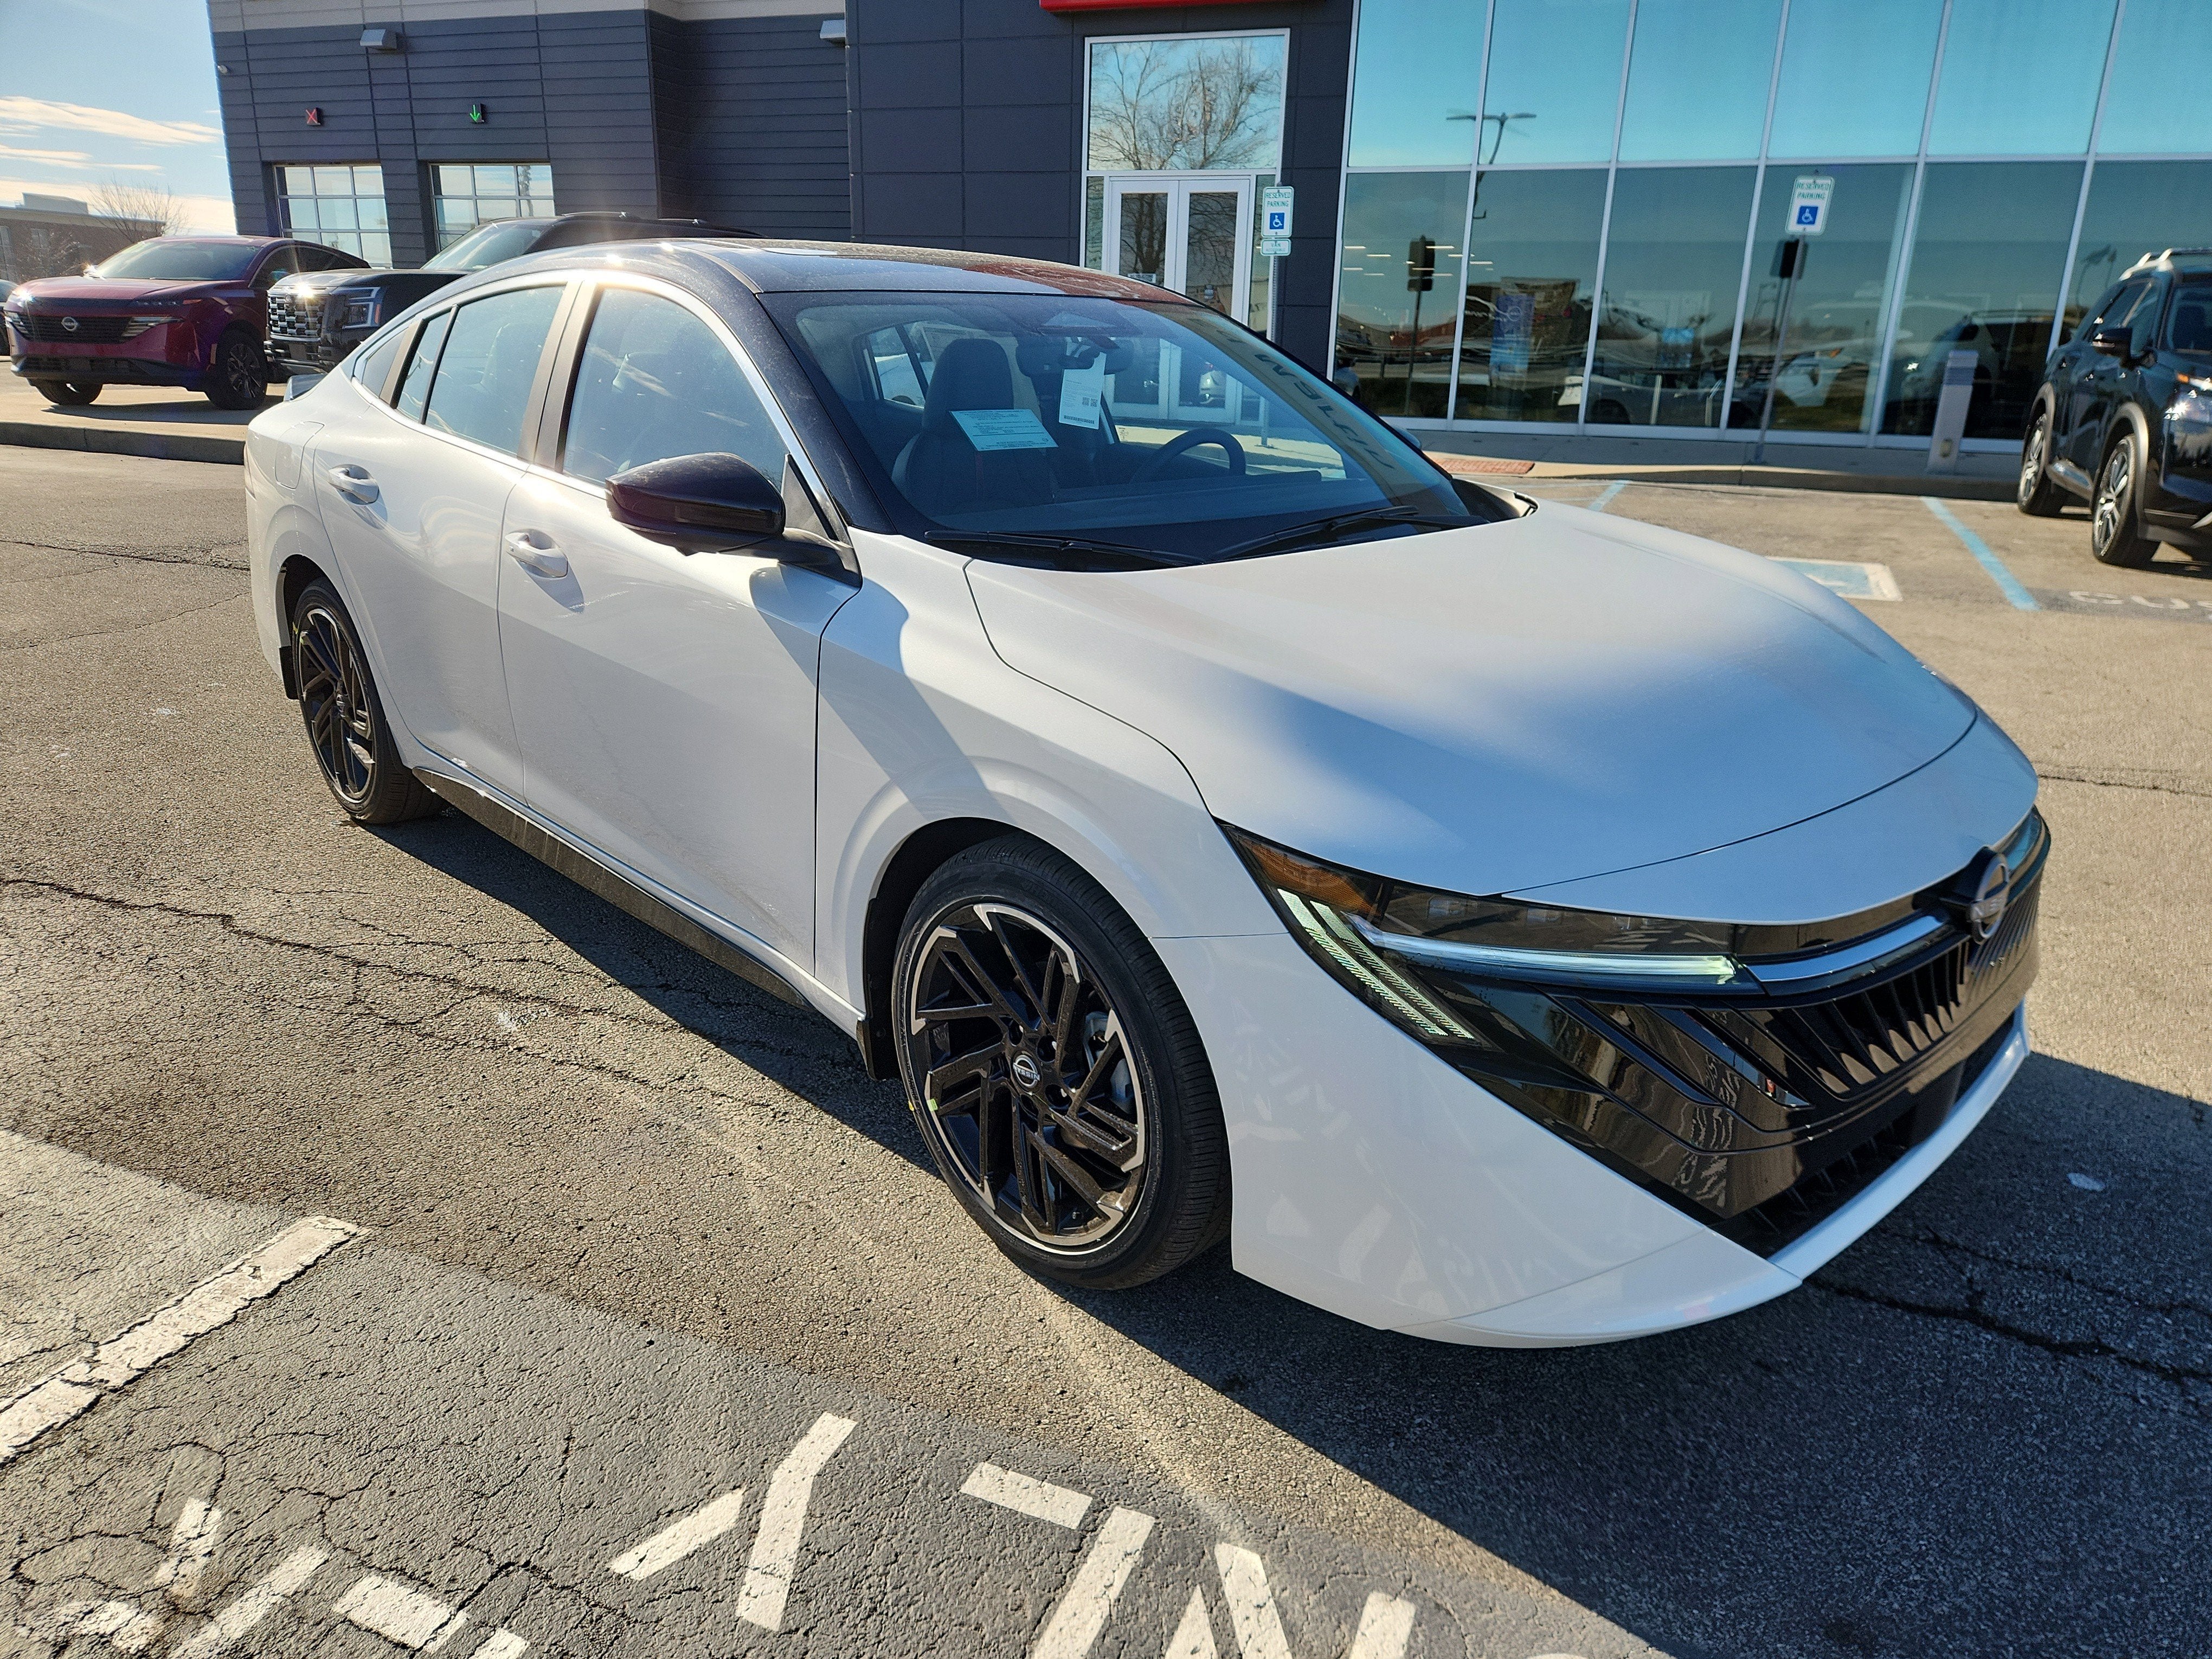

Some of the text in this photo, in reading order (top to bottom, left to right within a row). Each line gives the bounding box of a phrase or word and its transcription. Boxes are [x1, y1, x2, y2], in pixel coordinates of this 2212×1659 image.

[1797, 191, 1825, 200] PARKING
[2068, 590, 2212, 611] CU
[1013, 1063, 1040, 1081] NISSAN
